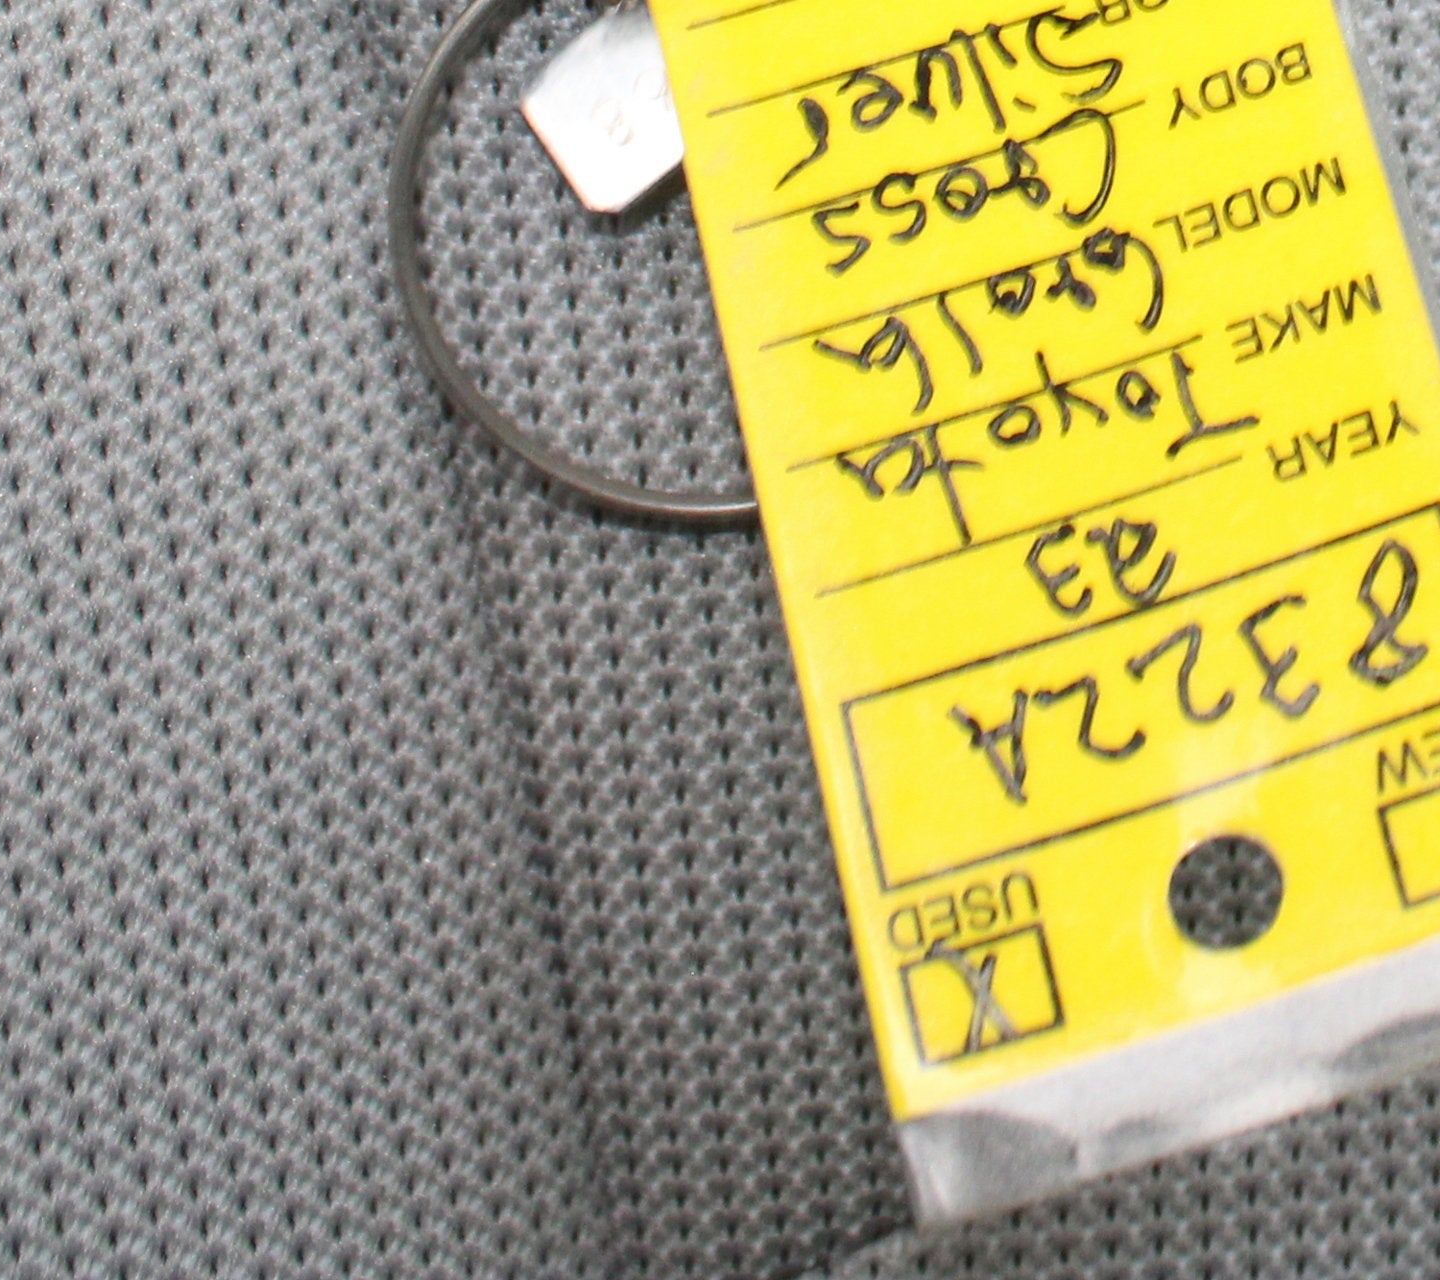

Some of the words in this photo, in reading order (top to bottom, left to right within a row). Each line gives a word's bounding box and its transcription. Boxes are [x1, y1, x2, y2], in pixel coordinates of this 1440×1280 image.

[774, 10, 1123, 192] Silver
[1169, 42, 1312, 130] BODY
[812, 108, 1116, 274] Cross
[1152, 156, 1348, 253] MODEL
[1224, 273, 1383, 364] MAKE
[836, 349, 1260, 544] Toyota
[1266, 400, 1421, 482] YEAR
[950, 537, 1429, 804] 8322A
[886, 869, 1040, 956] USED
